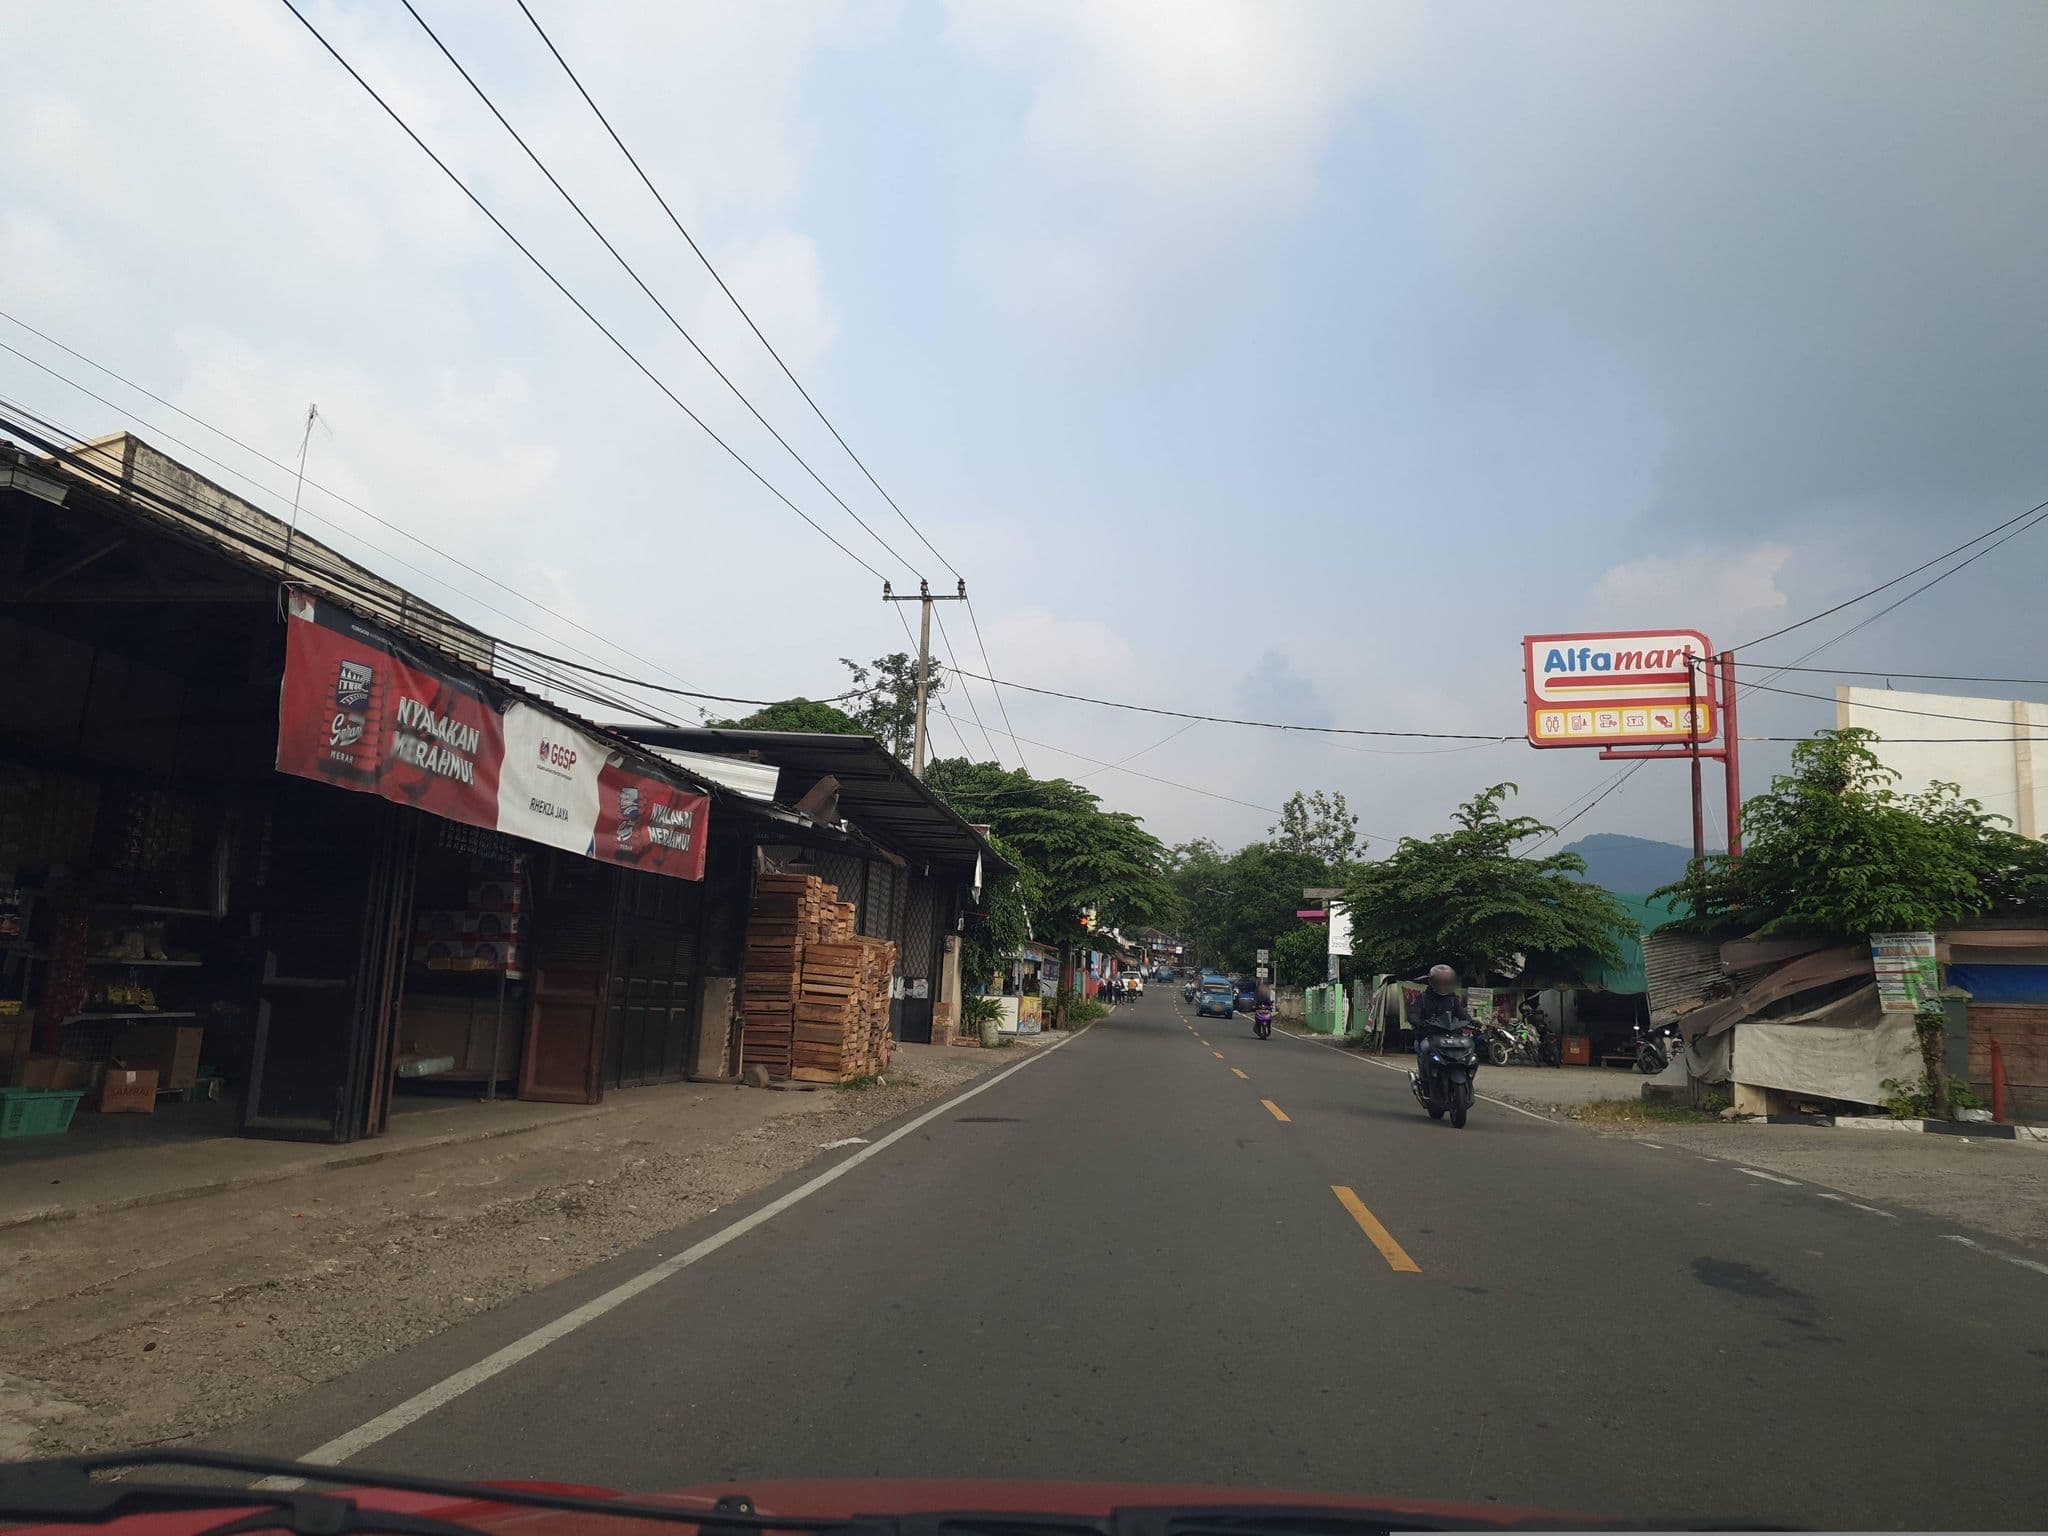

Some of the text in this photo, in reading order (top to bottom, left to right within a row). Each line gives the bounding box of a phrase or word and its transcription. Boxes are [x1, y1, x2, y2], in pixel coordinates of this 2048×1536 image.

[1544, 645, 1696, 673] Alfamart
[397, 696, 480, 754] NYALAKAN
[391, 731, 474, 785] MRAHMU!
[551, 743, 577, 771] GGSP
[529, 797, 569, 822] RHEKZA JAYA
